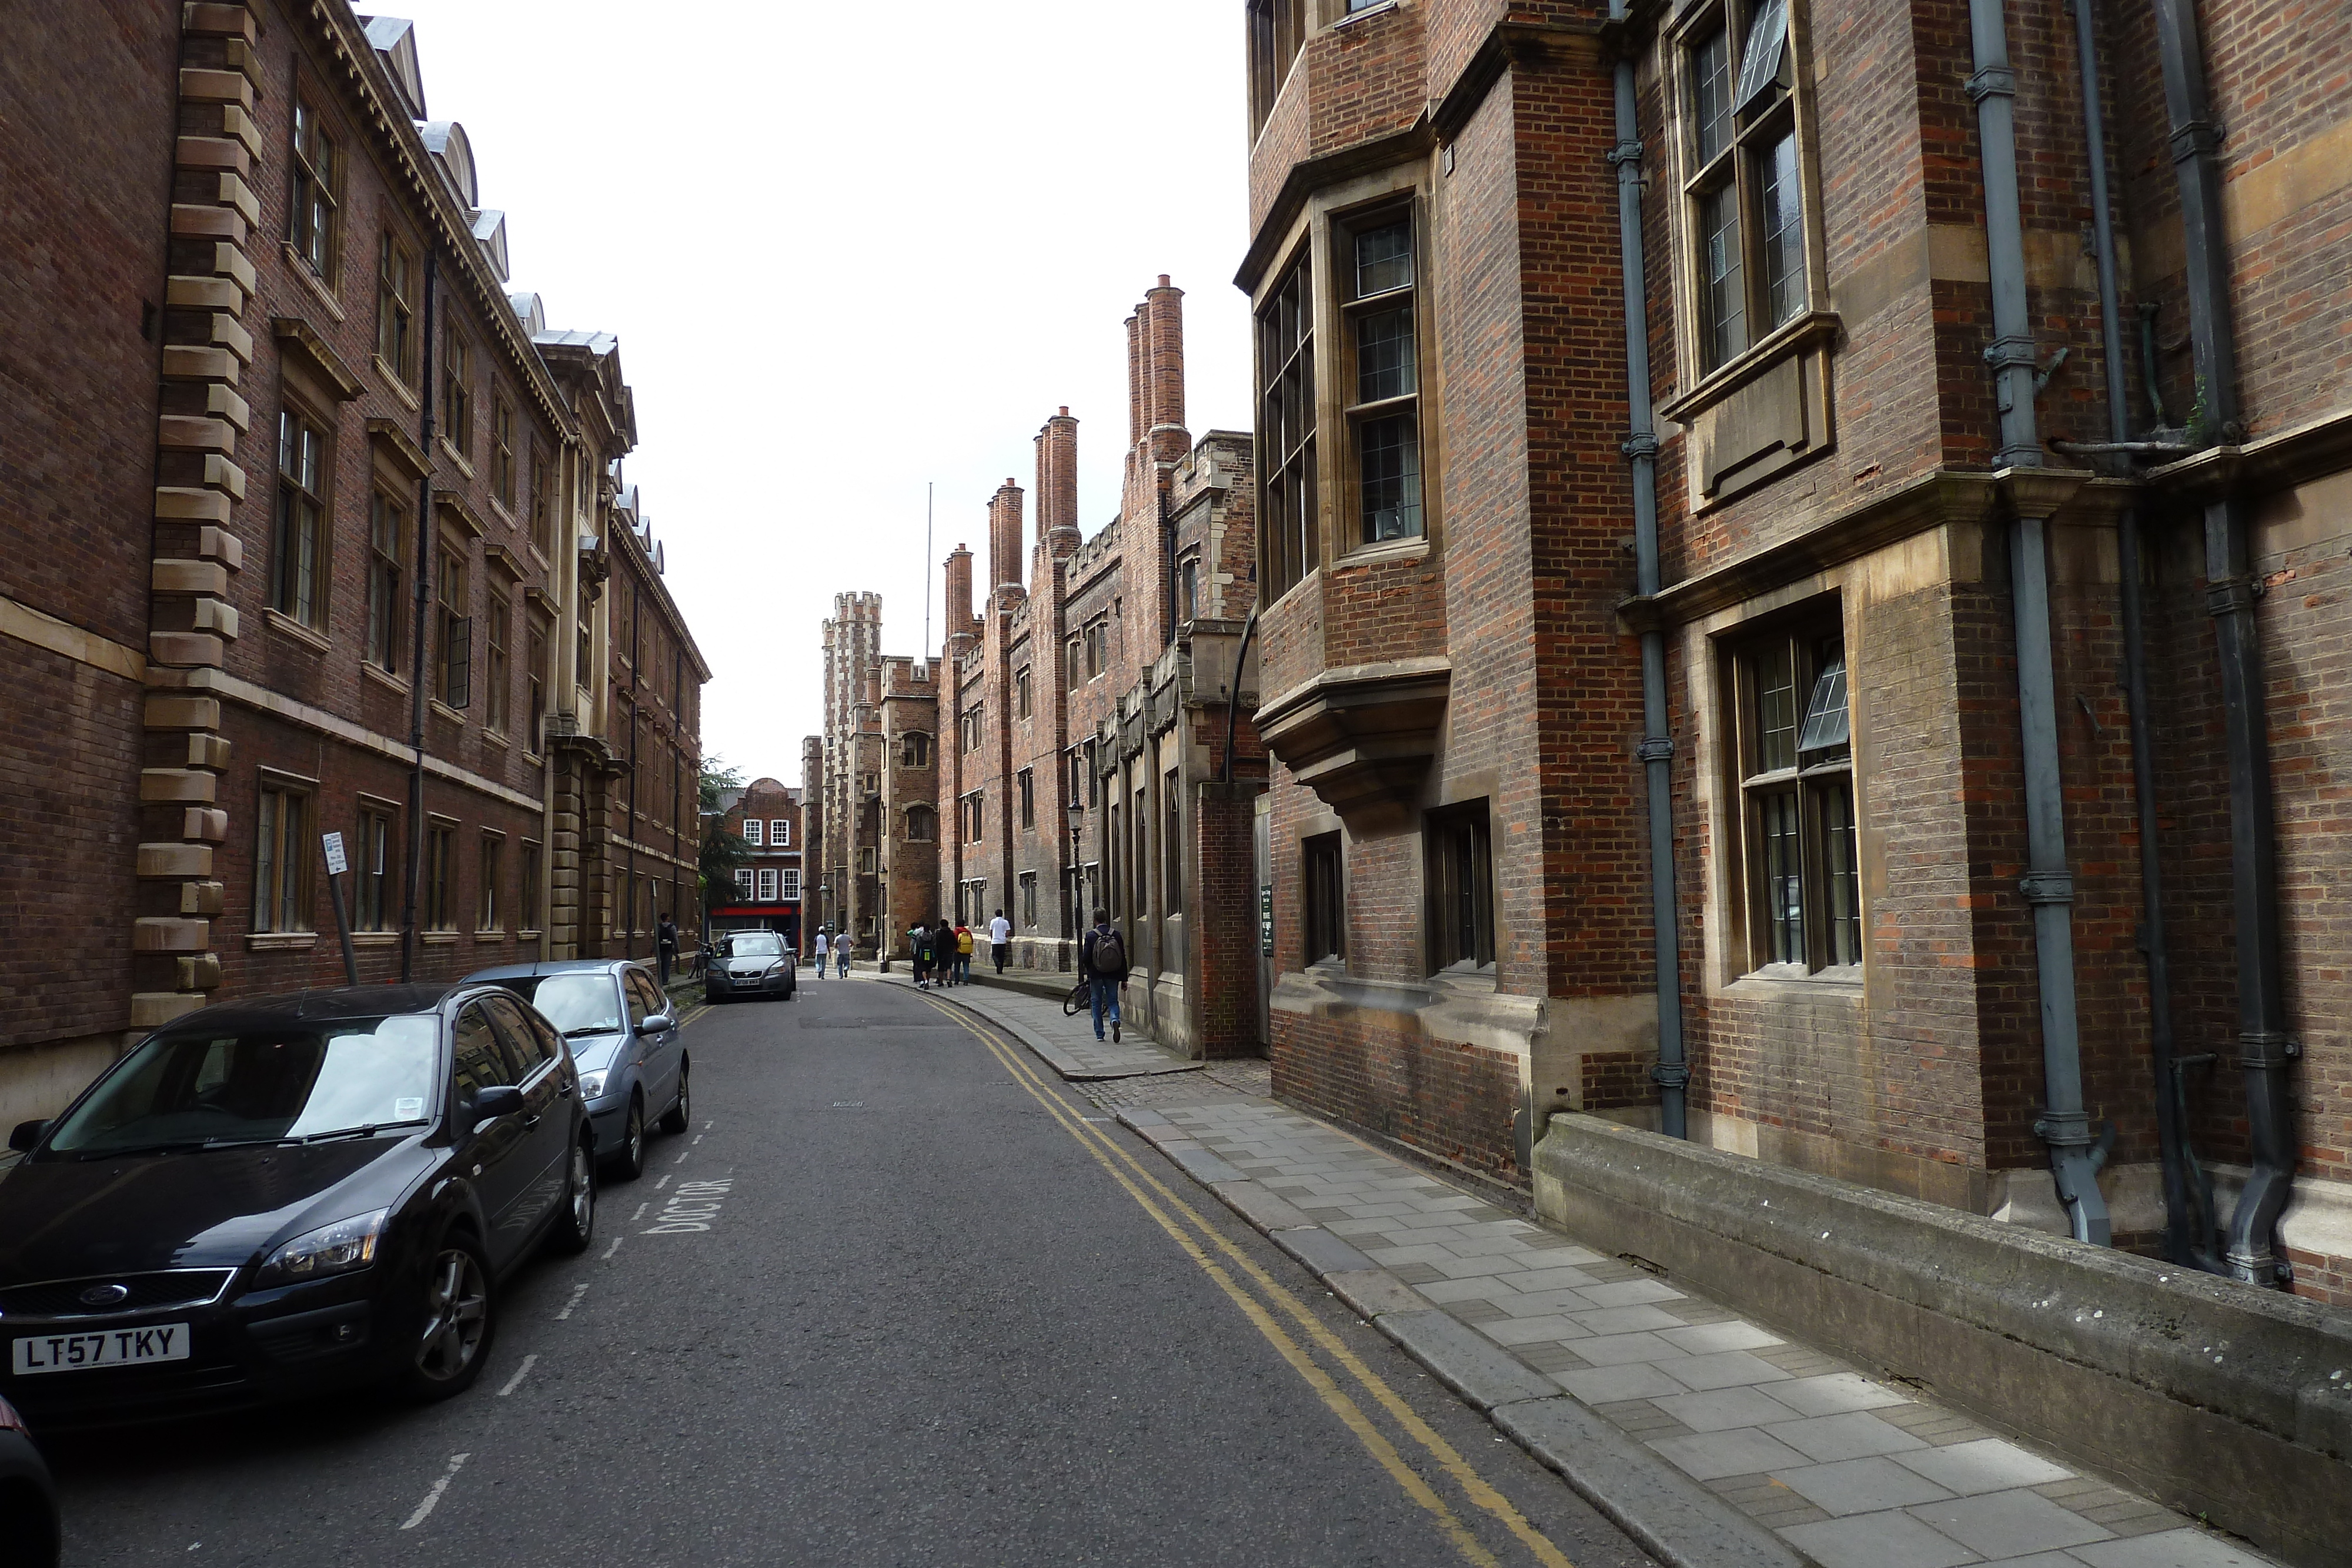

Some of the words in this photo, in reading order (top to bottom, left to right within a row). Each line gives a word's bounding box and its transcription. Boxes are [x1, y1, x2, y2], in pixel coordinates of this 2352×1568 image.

[639, 1178, 734, 1235] DOCTOR
[90, 1289, 117, 1300] Ford
[27, 1335, 105, 1368] LT57
[115, 1328, 175, 1359] TKY
